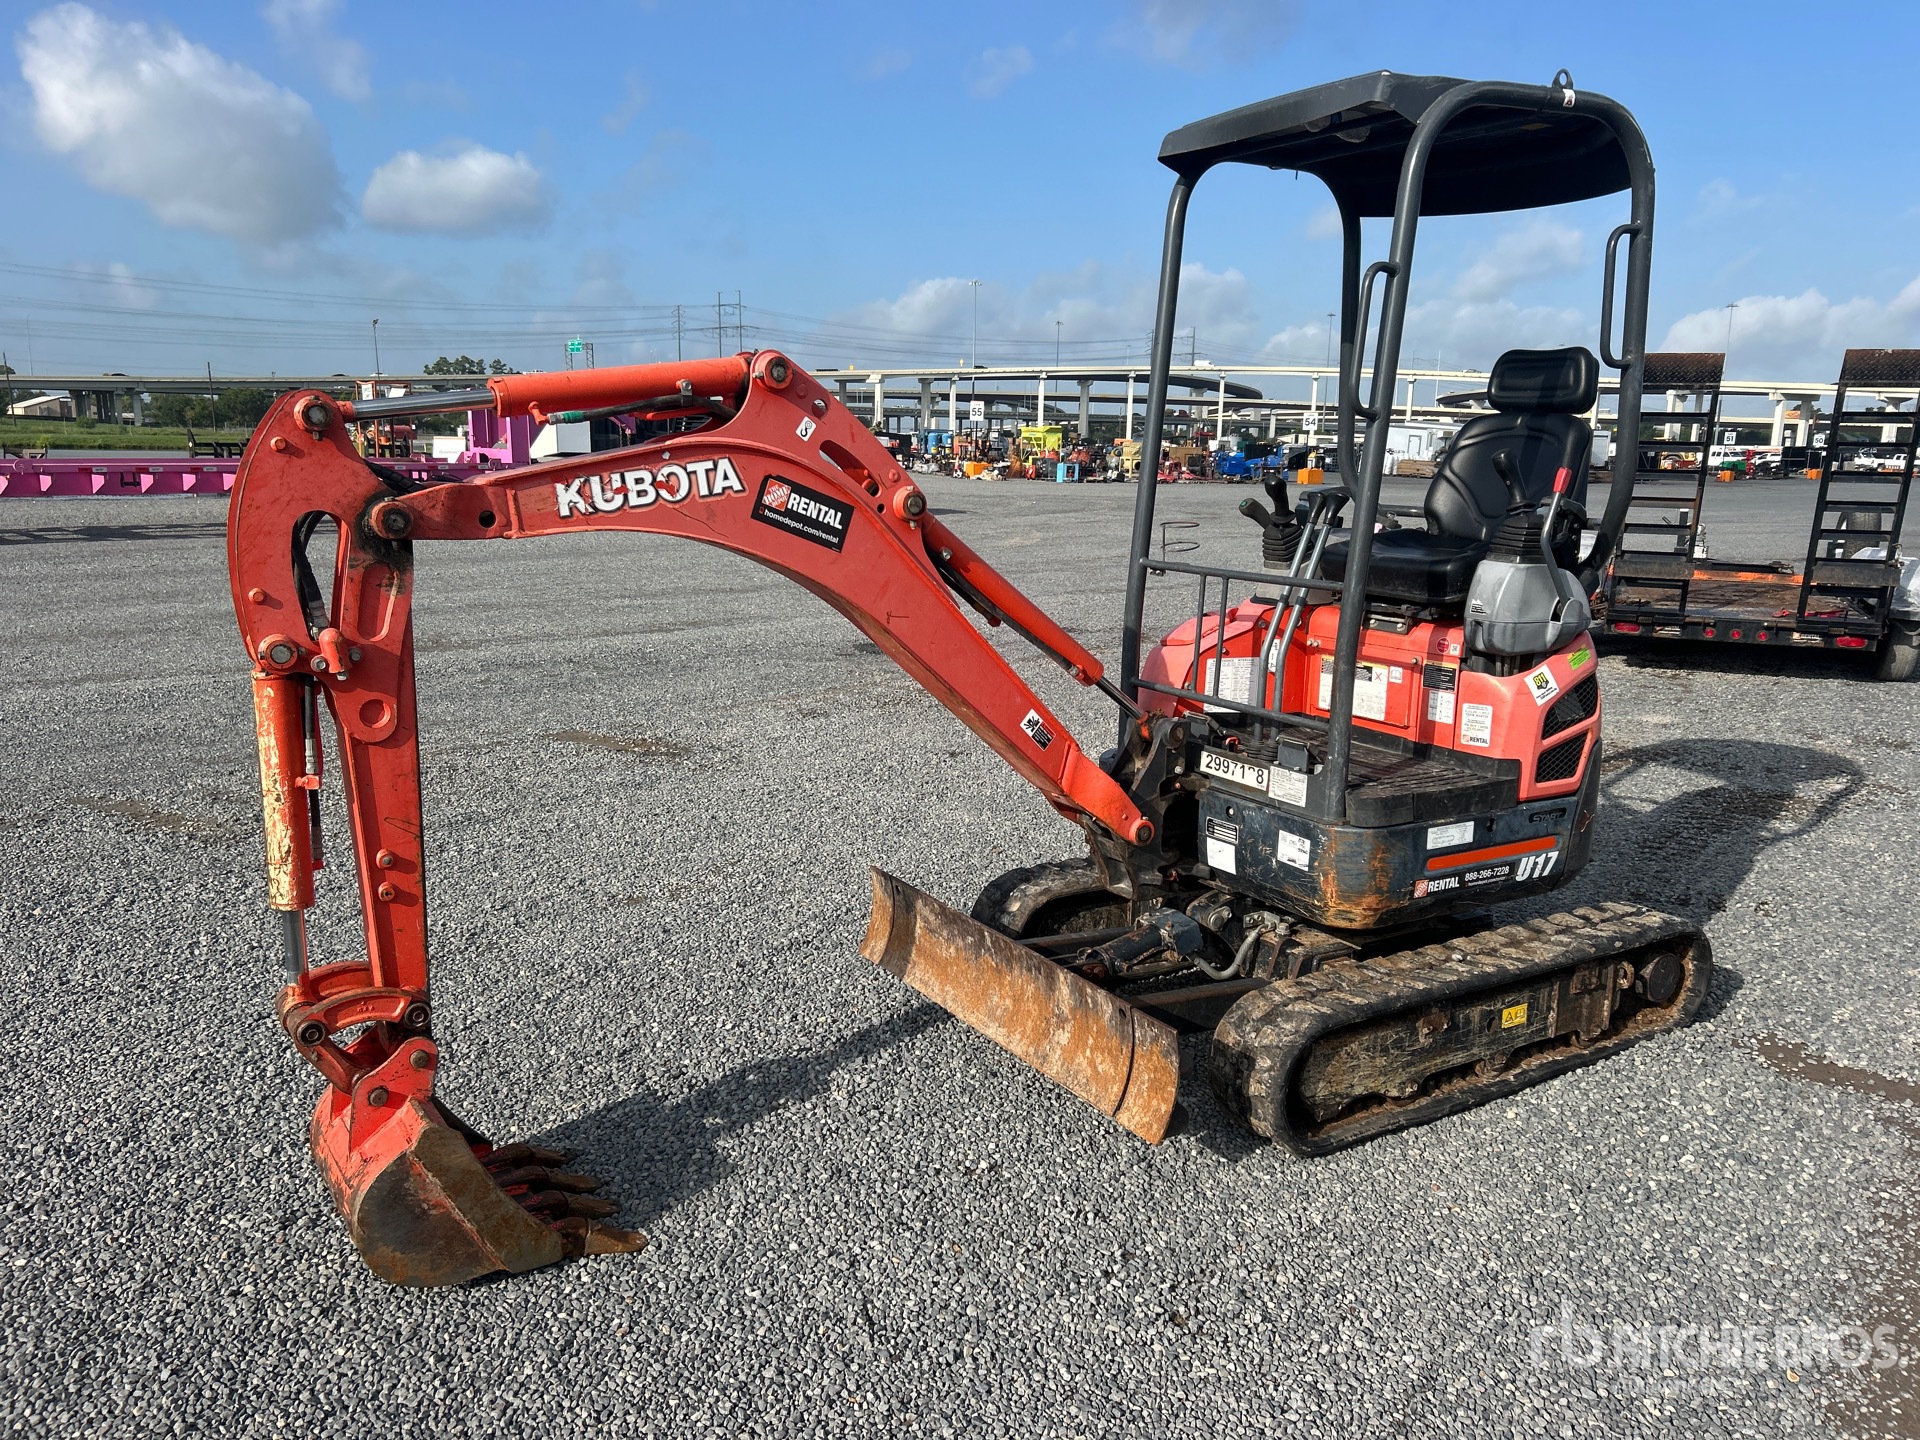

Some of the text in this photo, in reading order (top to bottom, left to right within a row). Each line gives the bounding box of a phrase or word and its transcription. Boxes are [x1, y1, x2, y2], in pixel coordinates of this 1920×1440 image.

[971, 407, 983, 417] 55
[1304, 417, 1316, 426] 54
[556, 456, 746, 518] KUBOTA
[763, 485, 790, 506] HOME
[787, 492, 843, 530] RENTAL
[764, 508, 840, 544] homedepot.com/rental
[1533, 671, 1548, 687] 811
[1464, 865, 1510, 881] 888-266-7228
[1515, 851, 1560, 882] U17
[1427, 876, 1460, 893] RENTAL
